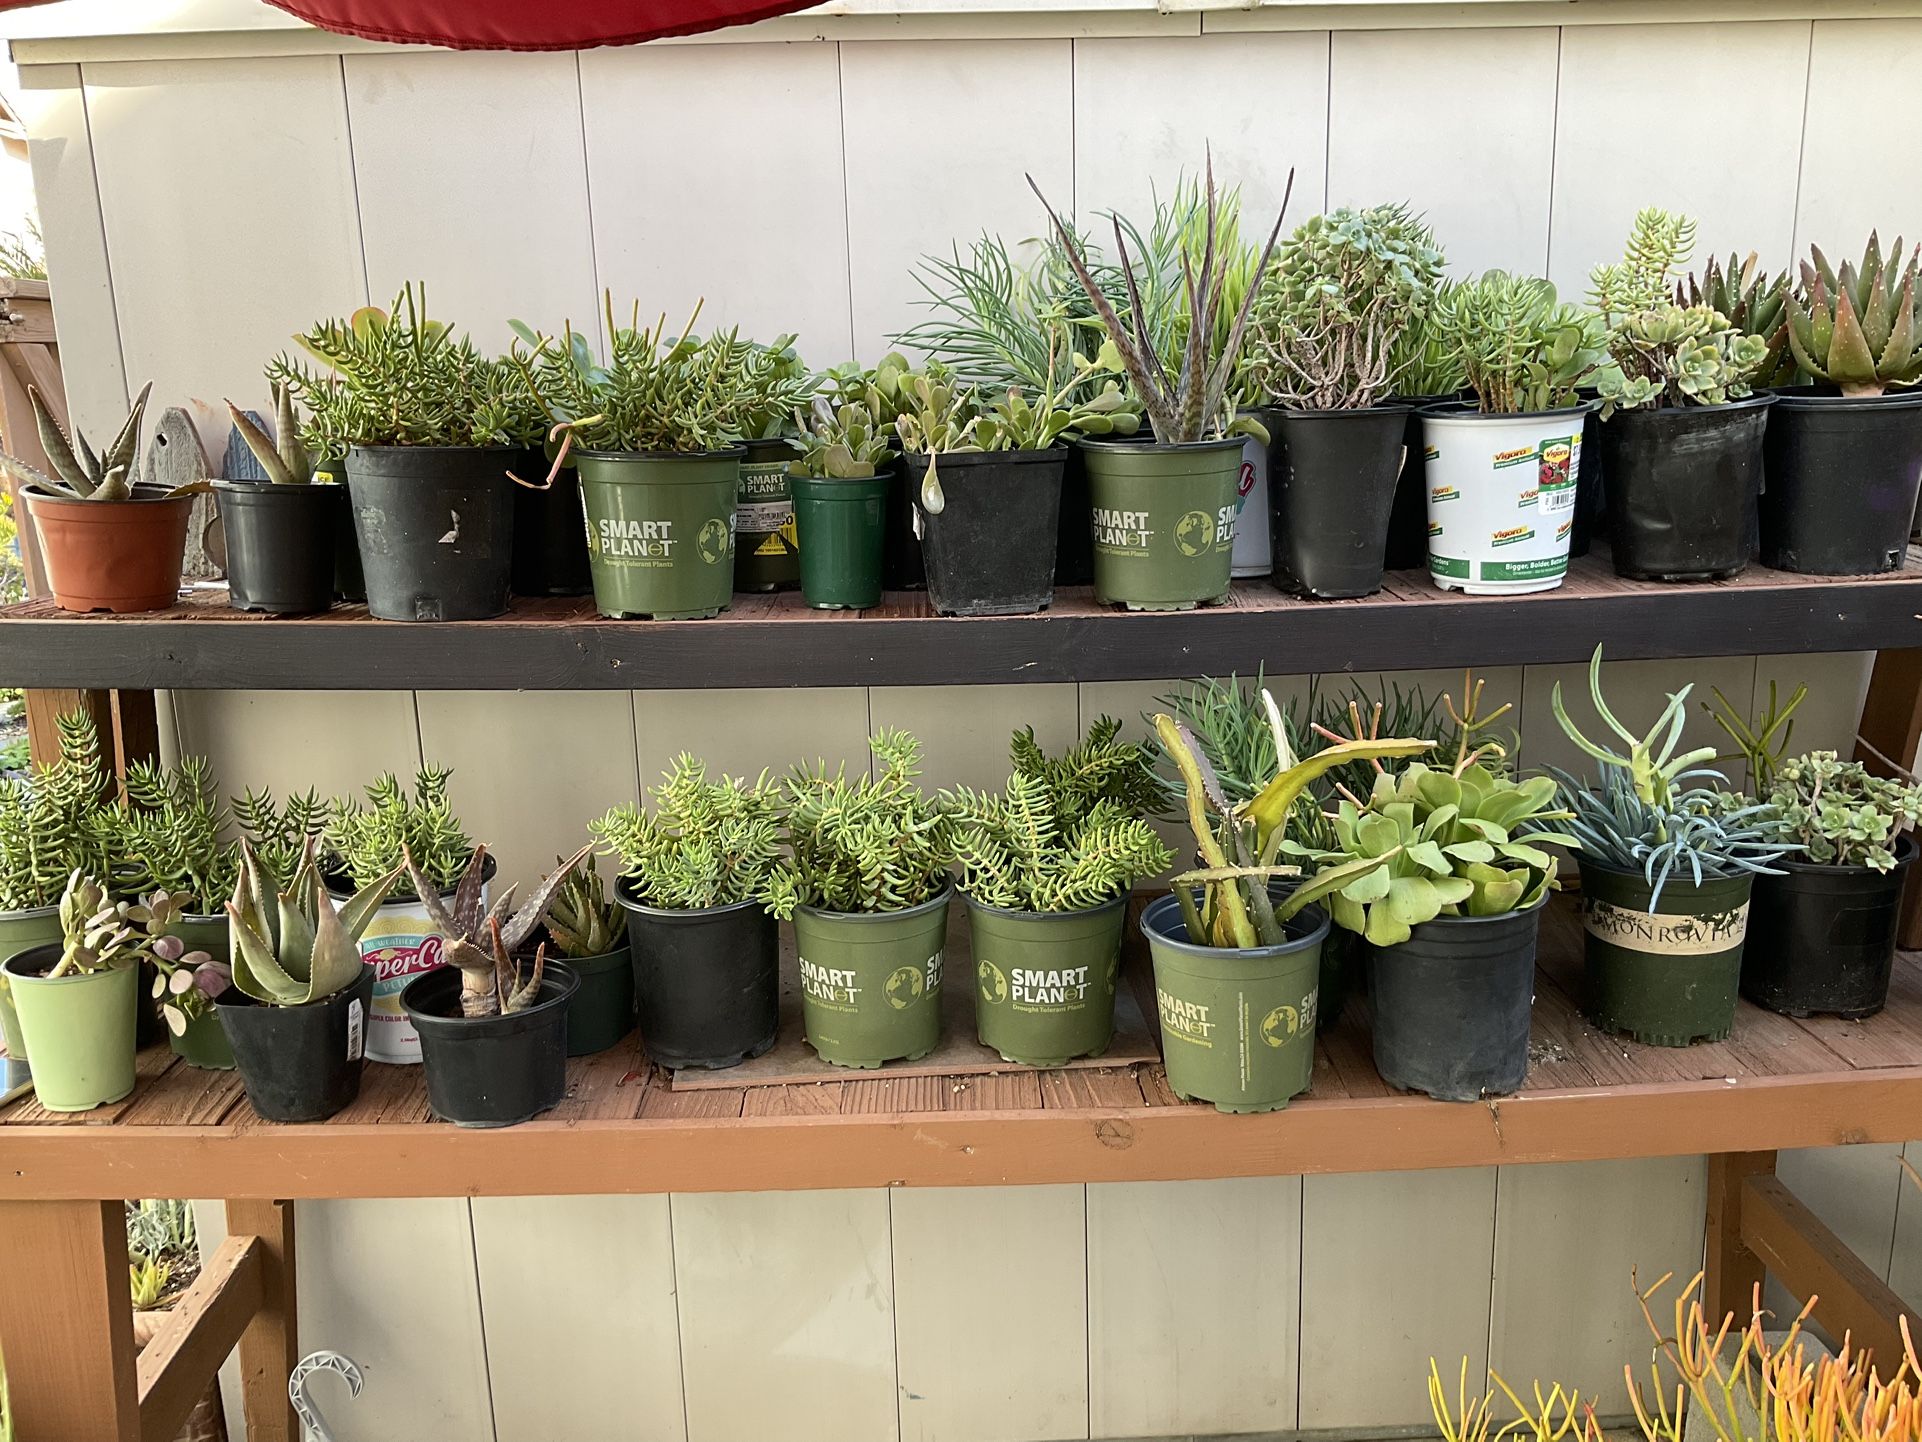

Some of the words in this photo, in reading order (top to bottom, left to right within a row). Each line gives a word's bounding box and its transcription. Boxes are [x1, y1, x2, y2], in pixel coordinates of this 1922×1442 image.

[746, 473, 785, 485] SMART
[1520, 488, 1538, 499] Vigo
[599, 519, 672, 539] SMART
[1092, 507, 1149, 530] SMART
[798, 956, 856, 987] SMART
[1011, 965, 1088, 988] SMART
[1012, 1003, 1039, 1013] Drought
[1039, 1005, 1067, 1013] Tolerant
[1067, 1003, 1086, 1011] Plants
[1158, 988, 1209, 1022] SMART
